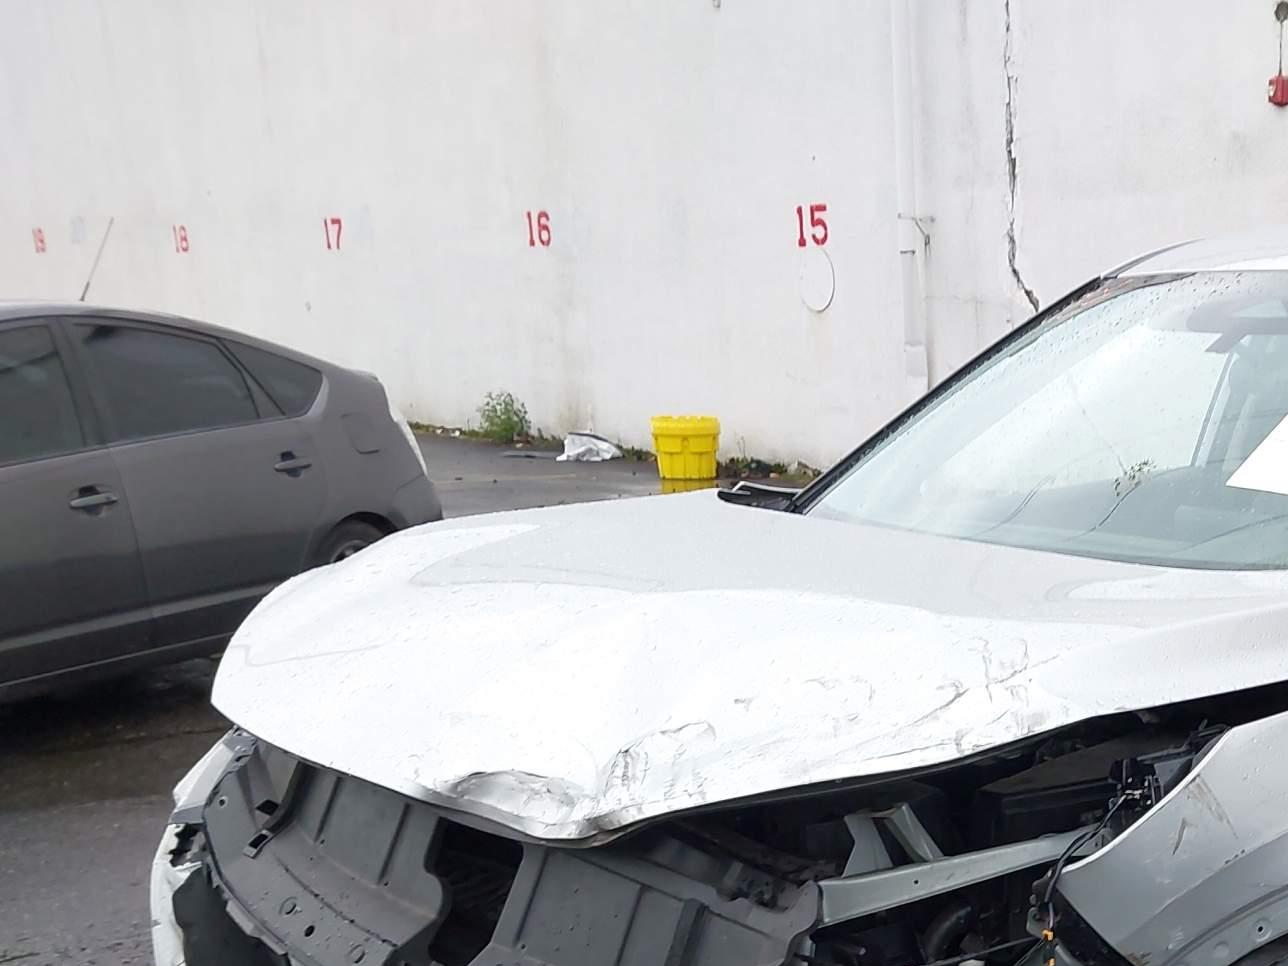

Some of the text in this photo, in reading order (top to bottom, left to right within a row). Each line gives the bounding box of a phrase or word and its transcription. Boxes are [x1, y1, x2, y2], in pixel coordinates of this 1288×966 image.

[173, 225, 189, 253] 18
[324, 217, 342, 250] 17
[526, 210, 551, 247] 16
[796, 203, 828, 248] 15
